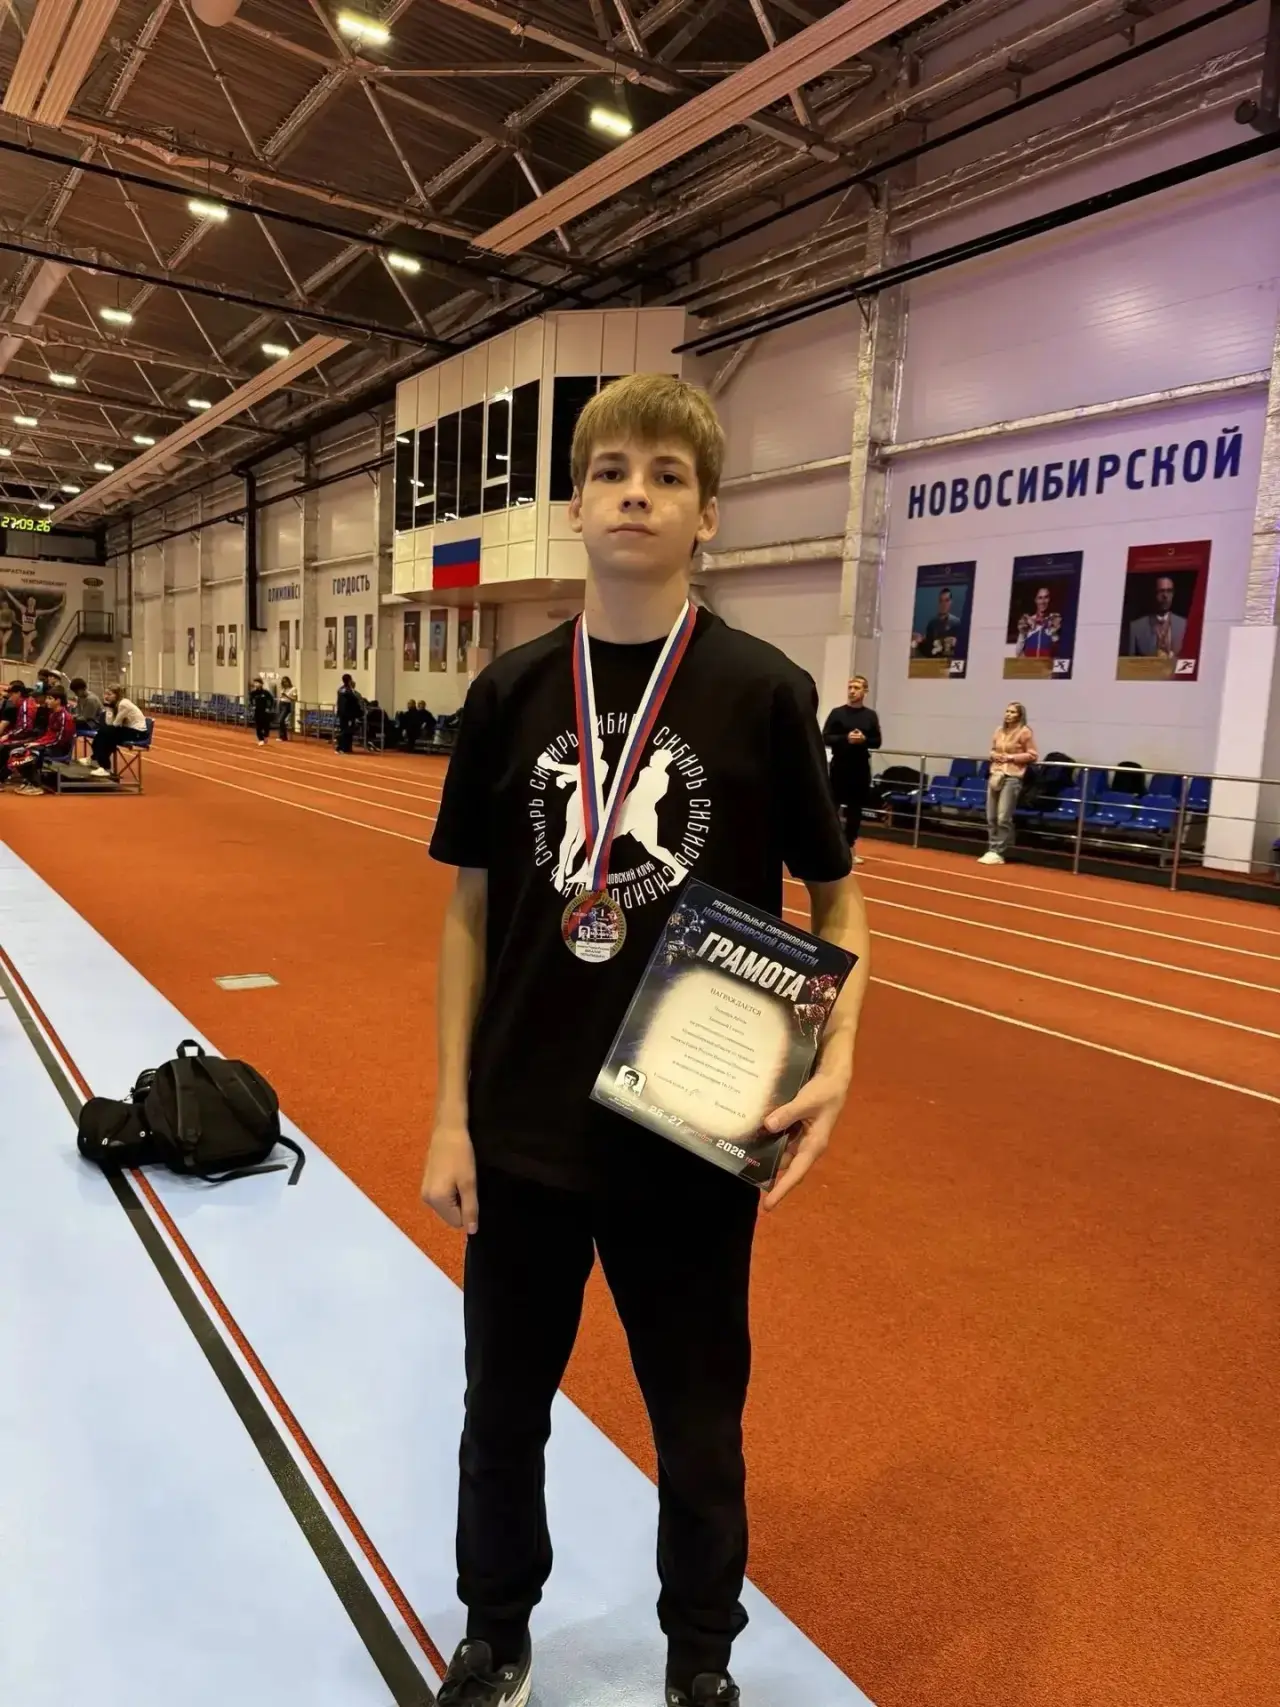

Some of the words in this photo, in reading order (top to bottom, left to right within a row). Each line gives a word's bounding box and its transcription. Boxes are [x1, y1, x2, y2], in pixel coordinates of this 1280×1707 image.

[908, 425, 1244, 519] НОВОСИБИРСКОЙ
[1, 516, 51, 532] 27.09.26
[268, 582, 300, 602] ОЛИМПИЙС
[332, 574, 370, 596] ГОРДОСТЬ
[529, 729, 579, 790] СИИРЬ
[652, 726, 708, 790] СИБИРЬ
[673, 799, 711, 867] СИБИРЬ
[636, 861, 656, 879] КЛУБ
[702, 907, 778, 946] НОВОСИБИРСКОЙ
[776, 942, 819, 968] ОБЛАСТИ
[712, 899, 767, 929] РЕГИОНАЛЬНЫЕ
[765, 924, 818, 953] СОРЕВНОВАНИЯ
[696, 931, 806, 1002] ГРАМОТА
[710, 987, 762, 1017] НАГРАЖДАЕТСЯ
[715, 1139, 746, 1159] 2026
